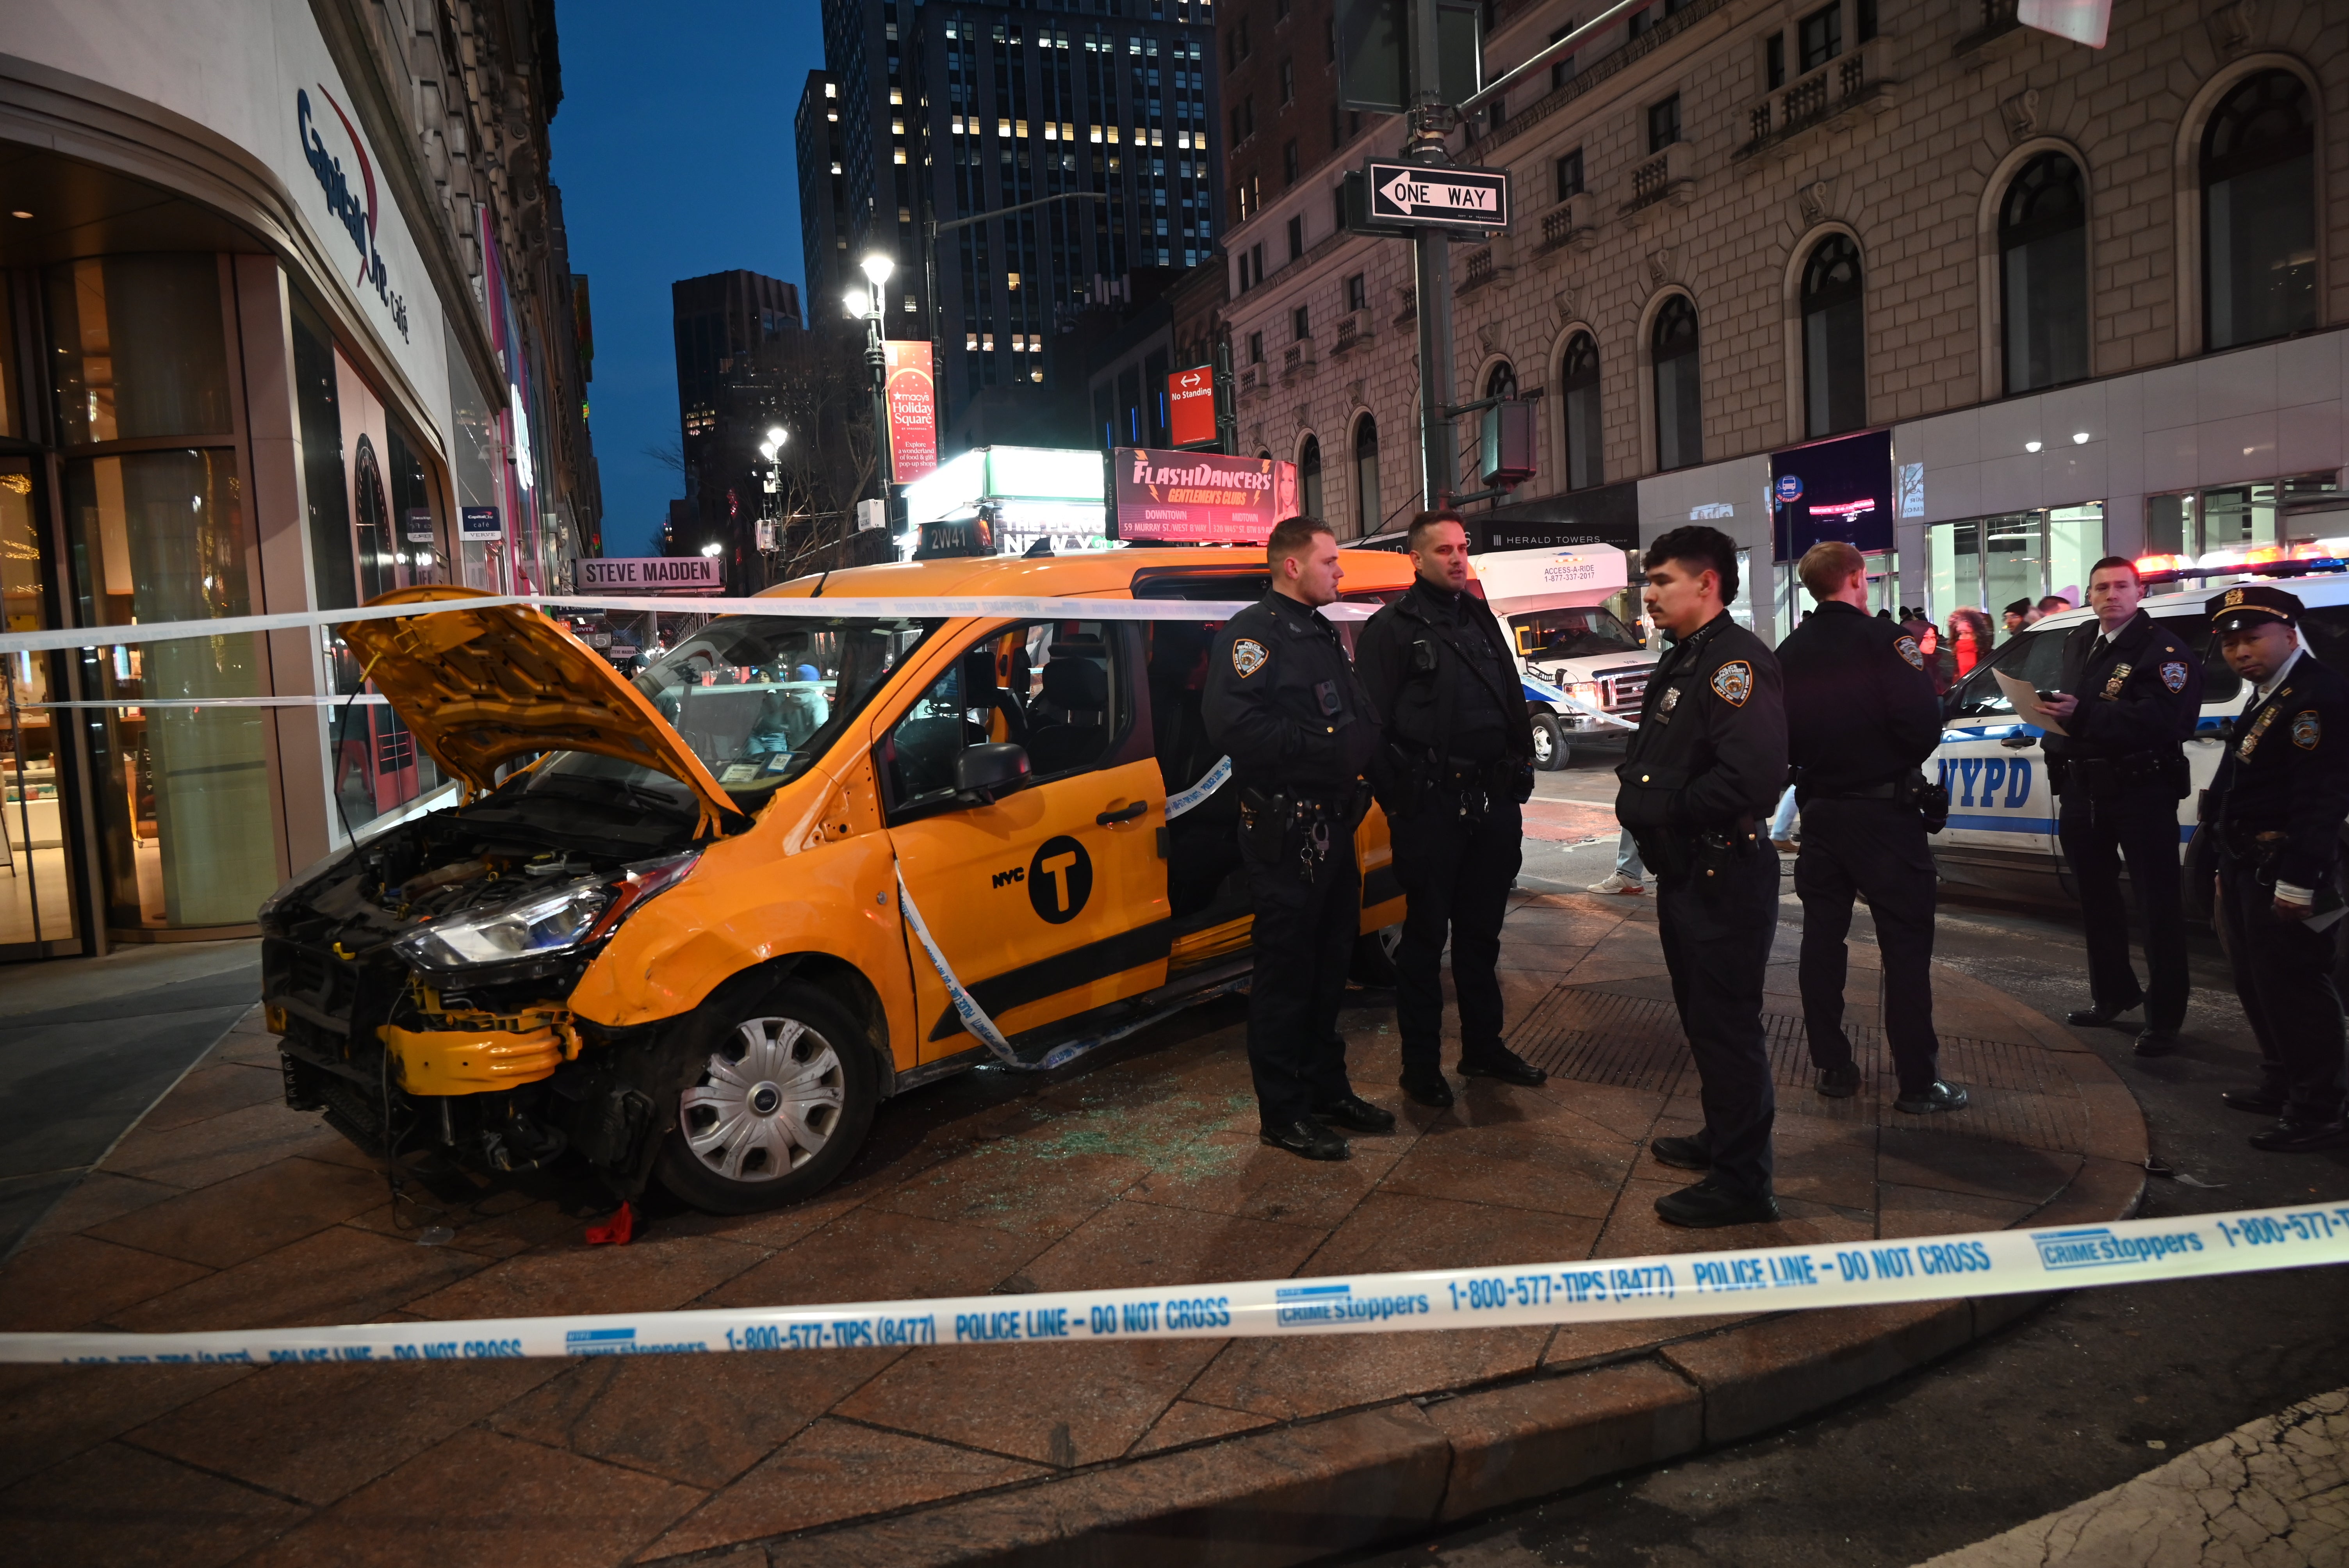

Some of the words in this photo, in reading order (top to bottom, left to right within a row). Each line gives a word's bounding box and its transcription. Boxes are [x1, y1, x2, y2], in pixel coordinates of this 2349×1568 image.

[298, 88, 367, 258] Capital
[362, 211, 389, 307] One
[1395, 183, 1430, 203] ONE
[1448, 187, 1486, 208] WAY
[902, 394, 929, 403] macy's
[1172, 393, 1181, 401] No
[1182, 387, 1212, 399] Standing
[893, 402, 934, 415] Holiday
[895, 413, 932, 426] Square
[1168, 488, 1222, 504] GENTLEMEN'S
[1222, 491, 1247, 506] CLUBS
[1782, 493, 1801, 502] STANDING
[1145, 510, 1187, 520] DOWNTOWN
[1232, 513, 1258, 522] MIDTOWN
[1006, 516, 1041, 532] THE
[1046, 517, 1106, 534] FLAVO
[1124, 523, 1132, 531] 59
[931, 526, 966, 550] 2W41
[1004, 534, 1067, 553] NEW
[586, 563, 637, 583] STEVE
[643, 561, 711, 581] MADDEN
[1544, 565, 1595, 575] ACCESS-A-RIDE
[1544, 572, 1595, 582] 1-877-337-2017
[1237, 645, 1265, 656] DEPARTMENT
[1244, 641, 1261, 650] POLICE
[1254, 657, 1264, 667] YORK
[1718, 664, 1738, 675] POLICE
[1714, 668, 1746, 683] DEPARTMENT
[1716, 686, 1726, 695] CITY
[1200, 777, 1217, 791] POLICE
[1937, 757, 2032, 808] NYPD
[992, 866, 1025, 889] NYC
[1041, 850, 1076, 912] T
[949, 987, 963, 1001] LINE
[957, 998, 976, 1019] POLICE
[2044, 1241, 2100, 1265] CRIME
[2099, 1231, 2205, 1262] stoppers
[1693, 1257, 1766, 1294] POLICE
[1769, 1254, 1818, 1287] LINE
[1836, 1250, 1870, 1283] DO
[1872, 1246, 1915, 1279] NOT
[1917, 1241, 1992, 1276] CROSS
[1448, 1270, 1608, 1311] 1-800-577-TIPS
[1609, 1265, 1675, 1302] (8477)
[1281, 1302, 1334, 1322] CRIME
[1333, 1291, 1430, 1322] stoppers
[955, 1311, 1021, 1342] POLICE
[1027, 1308, 1068, 1338] LINE
[1092, 1304, 1118, 1335] DO
[1122, 1301, 1160, 1333] NOT
[1165, 1296, 1231, 1329] CROSS
[725, 1319, 872, 1352] 1-800-577-TIPS
[877, 1313, 936, 1345] (8477)
[463, 1338, 526, 1359] CROSS
